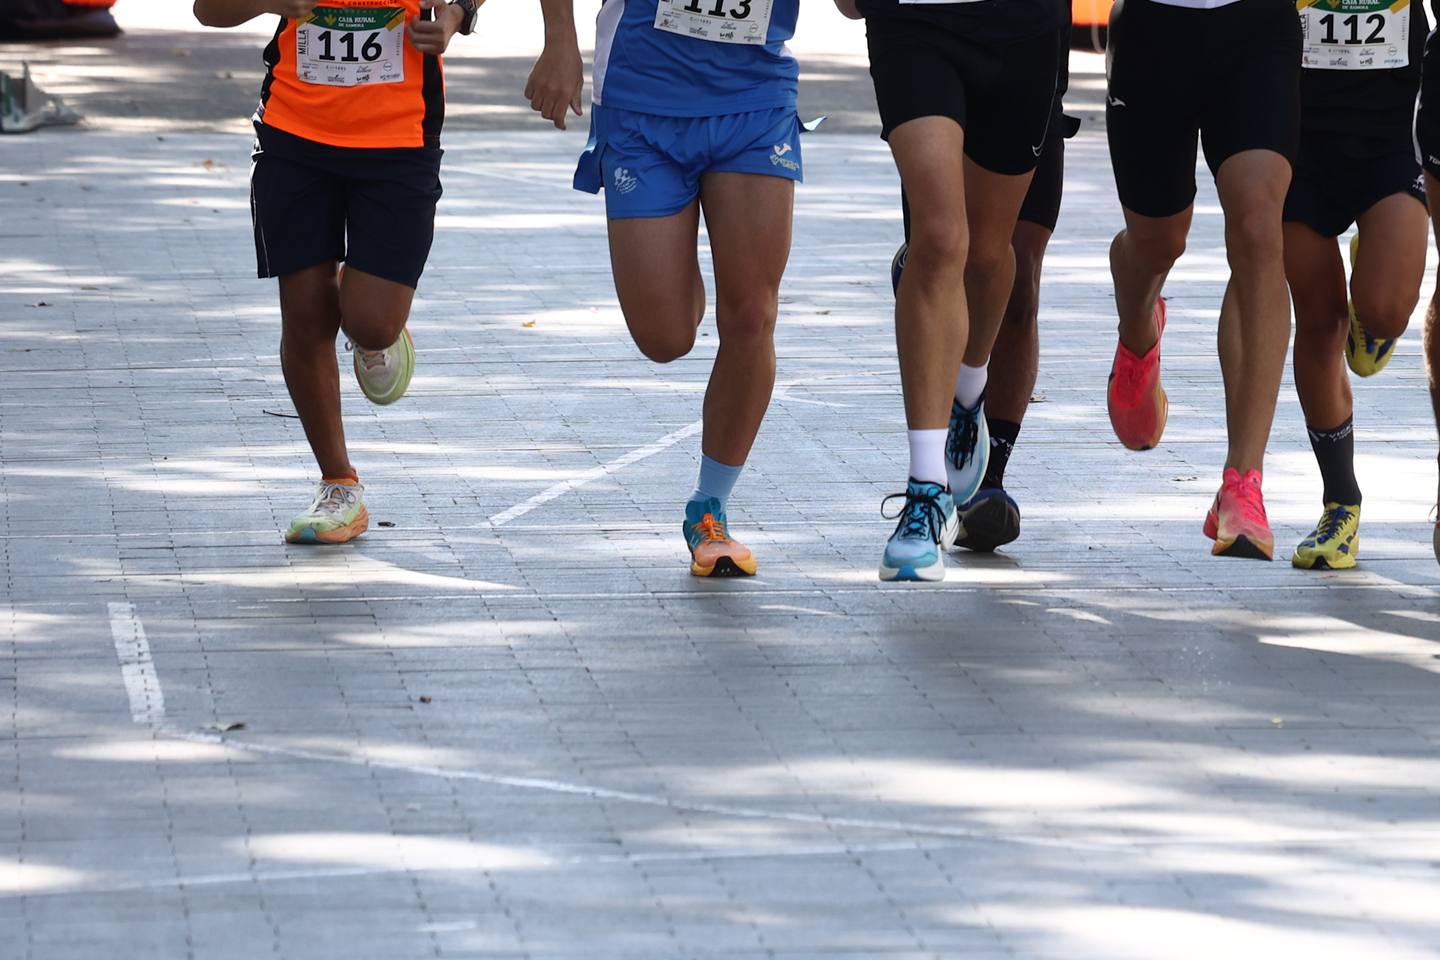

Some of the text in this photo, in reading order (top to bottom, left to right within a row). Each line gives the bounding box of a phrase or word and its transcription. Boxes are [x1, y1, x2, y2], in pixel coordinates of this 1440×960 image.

[298, 29, 307, 55] MILLA
[1319, 13, 1386, 45] 112
[318, 30, 382, 62] 116
